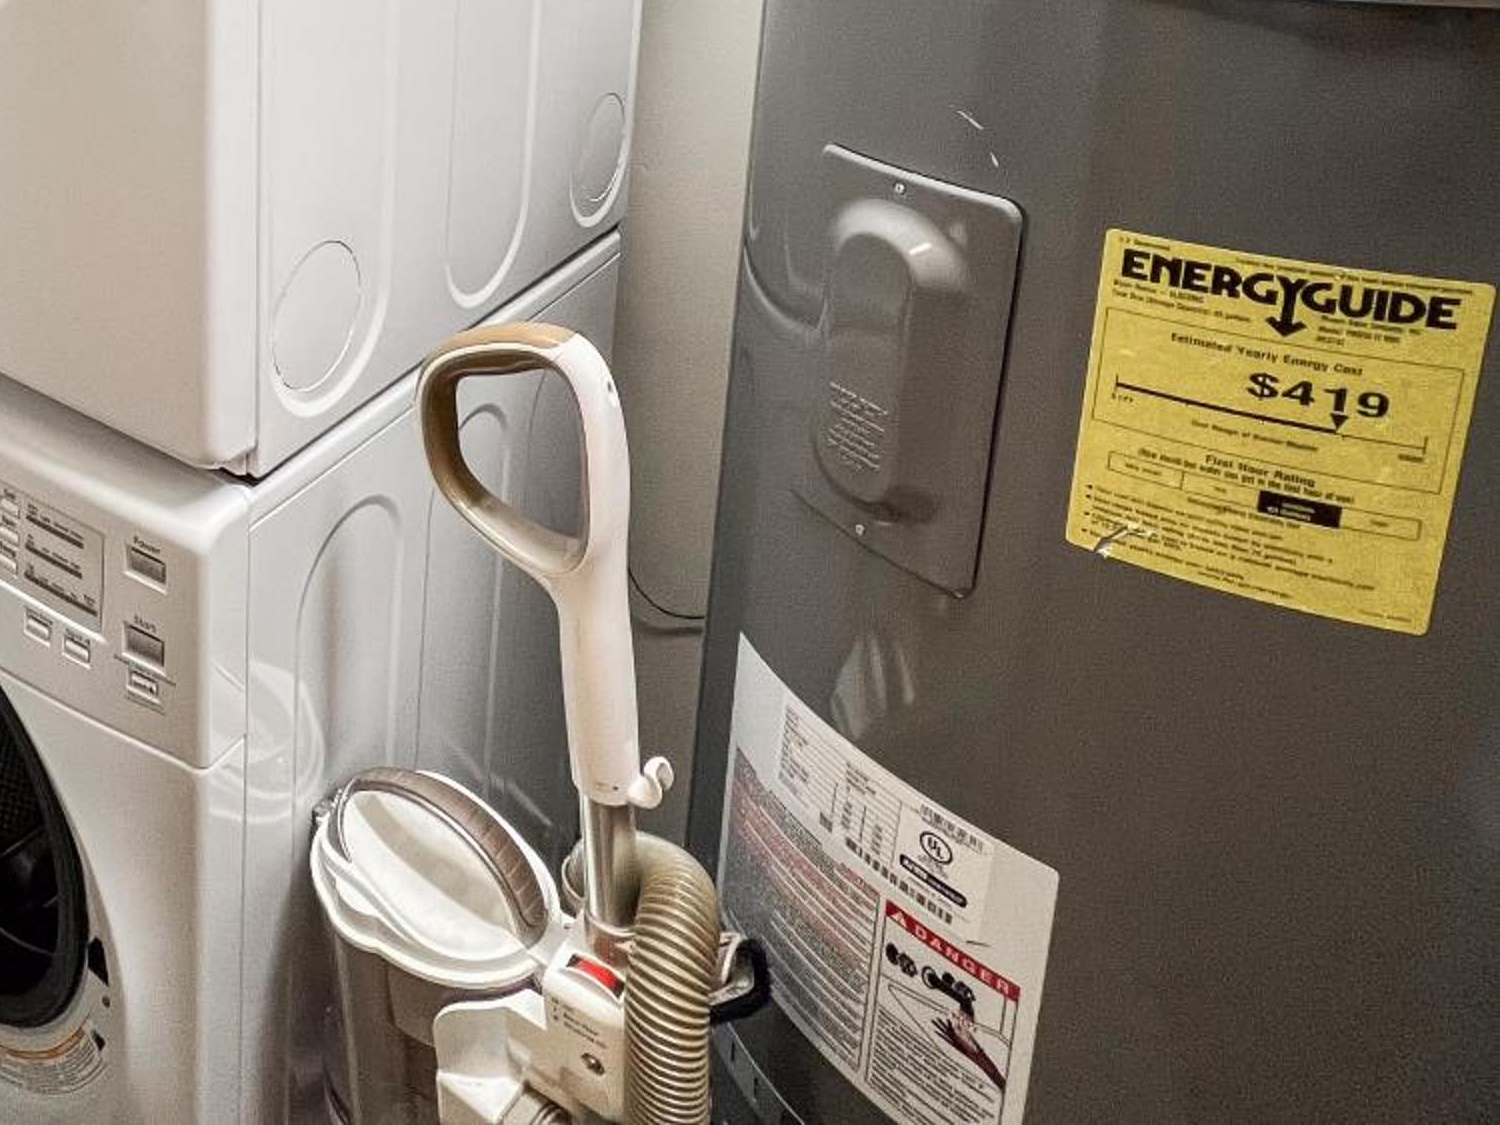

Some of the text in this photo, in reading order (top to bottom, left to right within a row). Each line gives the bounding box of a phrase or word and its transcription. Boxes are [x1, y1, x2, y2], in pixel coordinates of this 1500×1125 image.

[1121, 247, 1462, 337] ENERGYGUIDE
[1171, 332, 1364, 376] Estimated Yearly Energy Cost
[1247, 372, 1390, 418] $419
[1205, 454, 1233, 468] First
[1238, 462, 1269, 476] Hour
[1273, 469, 1316, 488] Rating
[914, 924, 1010, 995] DANGER
